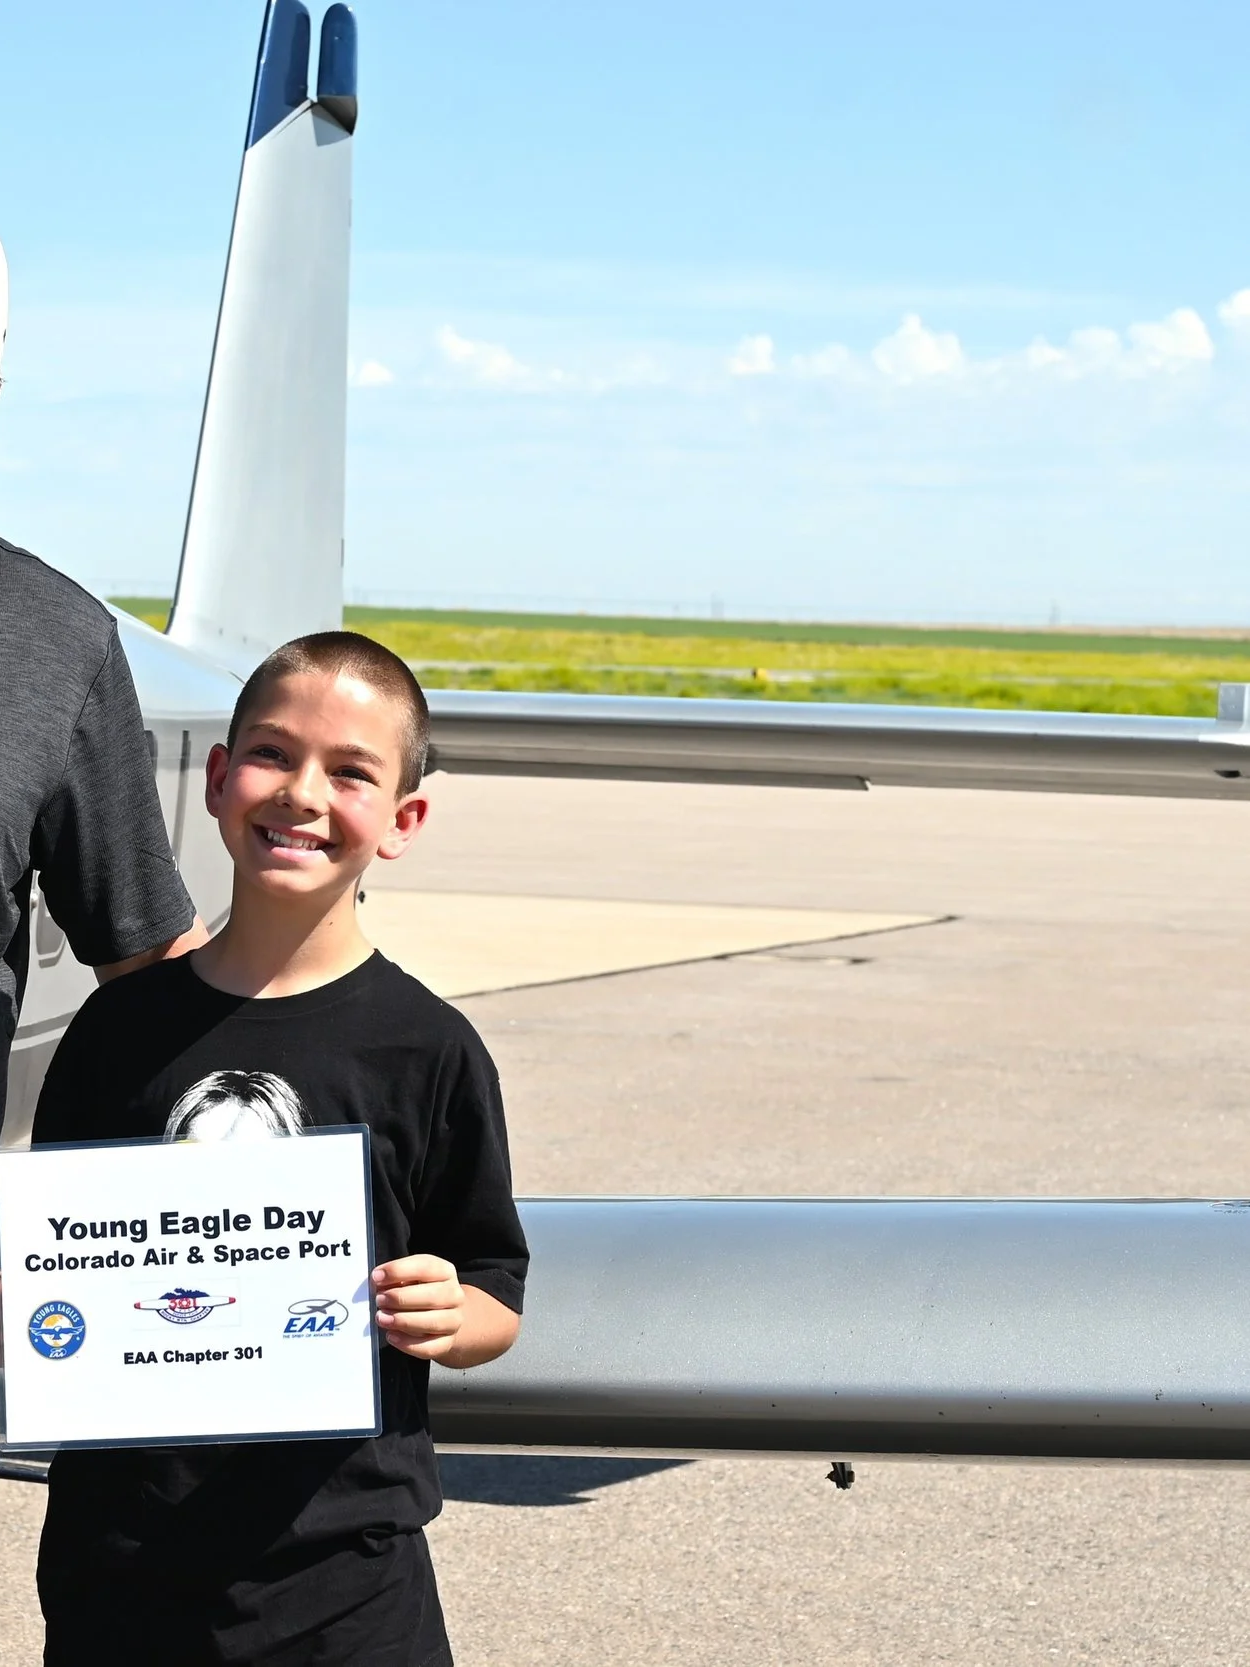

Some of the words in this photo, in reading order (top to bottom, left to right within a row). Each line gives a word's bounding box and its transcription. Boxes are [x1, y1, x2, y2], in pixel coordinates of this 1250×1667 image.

[47, 1217, 148, 1243] Young
[160, 1208, 252, 1240] Eagle
[263, 1206, 325, 1234] Day
[24, 1250, 135, 1272] Colorado
[143, 1248, 179, 1266] Air
[186, 1246, 205, 1264] &
[213, 1244, 291, 1267] Space
[299, 1239, 352, 1259] Port
[33, 1304, 55, 1324] YOUNG
[57, 1304, 80, 1323] EAGLES
[283, 1316, 336, 1333] EAA
[123, 1351, 158, 1365] EAA
[163, 1348, 229, 1365] Chapter
[234, 1346, 262, 1360] 301
